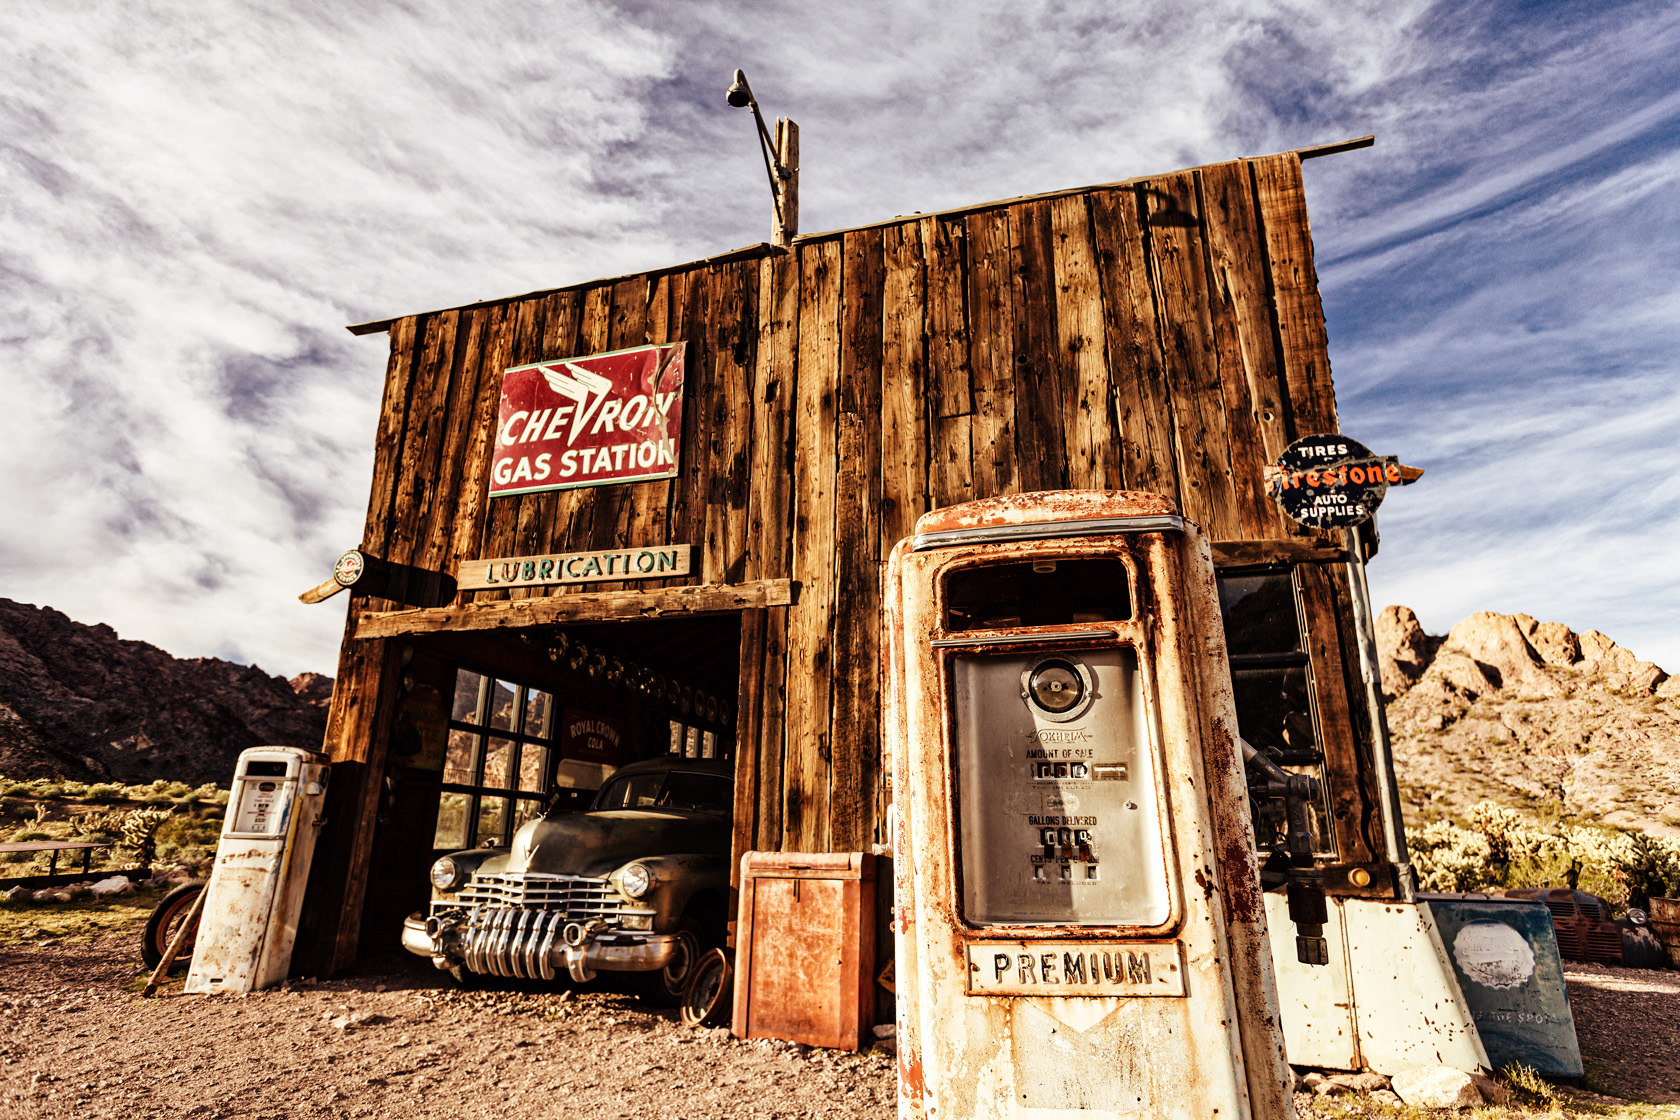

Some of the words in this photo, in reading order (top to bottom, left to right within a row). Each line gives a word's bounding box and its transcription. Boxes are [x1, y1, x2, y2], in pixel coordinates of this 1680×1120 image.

[499, 390, 677, 448] CHEVRON
[1298, 444, 1348, 458] TIRES
[493, 452, 552, 486] GAS
[558, 438, 676, 478] STATION
[1315, 494, 1348, 505] AUTO
[1300, 504, 1364, 519] SUPPLIES
[485, 550, 679, 584] LUBRICATION
[570, 720, 596, 739] ROYAL
[596, 721, 621, 748] CROWN
[587, 737, 604, 750] COLA
[1025, 749, 1059, 759] AMOUNT
[1062, 749, 1072, 759] OF
[1075, 749, 1094, 759] SALE
[1028, 815, 1060, 826] GALLONS
[1062, 815, 1098, 826] DELIVERED
[993, 951, 1150, 985] PREMIUM
